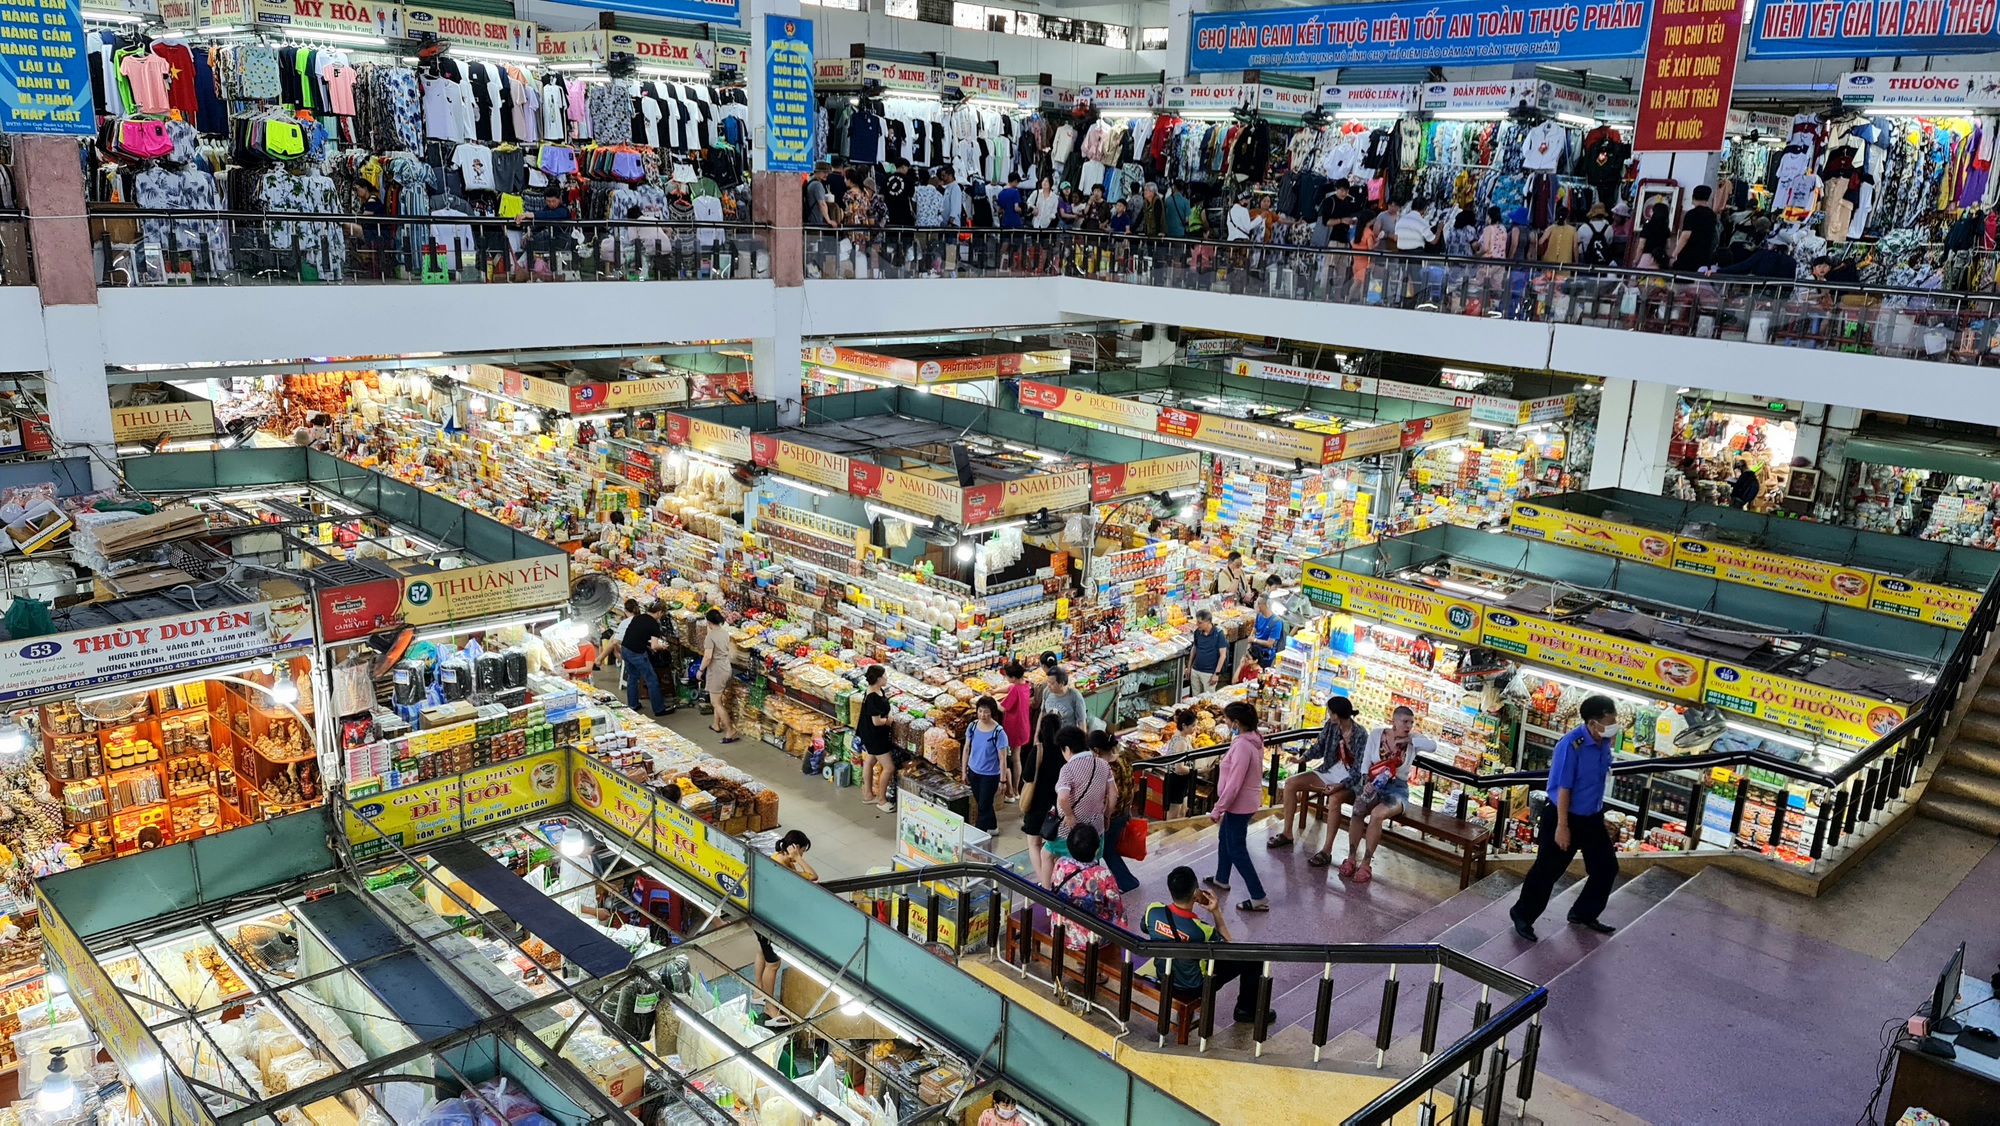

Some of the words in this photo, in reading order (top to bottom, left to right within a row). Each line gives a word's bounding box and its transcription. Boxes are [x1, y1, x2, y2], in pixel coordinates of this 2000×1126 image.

[329, 1, 372, 23] HÒA
[354, 26, 373, 35] Trang
[437, 15, 481, 37] HƯƠNG
[484, 23, 508, 40] SEN
[1199, 25, 1226, 53] CHỢ
[1229, 22, 1257, 47] HÀN
[1261, 24, 1292, 46] CAM
[1297, 15, 1324, 45] KẾT
[1328, 18, 1368, 49] THỰC
[1372, 13, 1409, 46] HIỆN
[1414, 7, 1445, 41] TỐT
[1448, 15, 1471, 38] AN
[1477, 6, 1523, 36] TOÀN
[1529, 4, 1579, 38] THỰC
[1664, 26, 1682, 46] THU
[1684, 16, 1704, 45] CHỦ
[1706, 17, 1725, 43] YẾU
[636, 38, 689, 59] DIỄM
[882, 64, 896, 79] TỐ
[899, 72, 925, 82] MINH
[1658, 50, 1673, 77] ĐỂ
[1672, 54, 1693, 77] XÂY
[1693, 55, 1721, 80] DỰNG
[56, 79, 70, 90] VI
[1889, 75, 1961, 90] THƯƠNG
[18, 93, 32, 104] VI
[1114, 88, 1146, 102] HẠNH
[1190, 86, 1211, 97] PHÚ
[1213, 86, 1235, 98] QUÝ
[1276, 91, 1291, 101] PHÚ
[1650, 86, 1662, 109] VÀ
[1664, 85, 1689, 109] PHÁT
[1691, 80, 1720, 107] TRIỂN
[1656, 114, 1675, 140] ĐẤT
[1675, 115, 1703, 139] NƯỚC
[1238, 364, 1247, 375] 14
[581, 388, 593, 399] 39
[1489, 399, 1498, 407] 13
[117, 411, 160, 427] THU
[164, 405, 192, 422] HÀ
[1170, 412, 1187, 422] 26
[702, 424, 720, 438] MAI
[1330, 438, 1340, 447] 26
[790, 445, 821, 464] SHOP
[823, 454, 848, 473] NHI
[899, 475, 924, 493] NAM
[927, 484, 958, 504] ĐỊNH
[1020, 479, 1050, 496] NAM
[1052, 472, 1086, 490] ĐỊNH
[1716, 555, 1748, 568] KIM
[411, 586, 428, 602] 52
[1450, 610, 1465, 626] 153
[73, 624, 151, 654] THÙY
[159, 611, 252, 642] DUYÊN
[4, 650, 17, 659] LÔ
[30, 644, 52, 657] 53
[17, 689, 32, 697] ĐT:
[35, 685, 55, 694] 0905
[97, 675, 111, 684] ĐT
[132, 667, 152, 677] 0236
[155, 664, 174, 673] 3840
[175, 662, 190, 670] 432
[197, 657, 213, 666] Nhà
[239, 649, 258, 658] 0236
[1750, 686, 1788, 705] LỘC
[1751, 675, 1772, 686] GIA
[1775, 681, 1788, 691] VỊ
[1791, 684, 1826, 699] THỰC
[392, 793, 419, 806] GIA
[424, 788, 439, 797] VỊ
